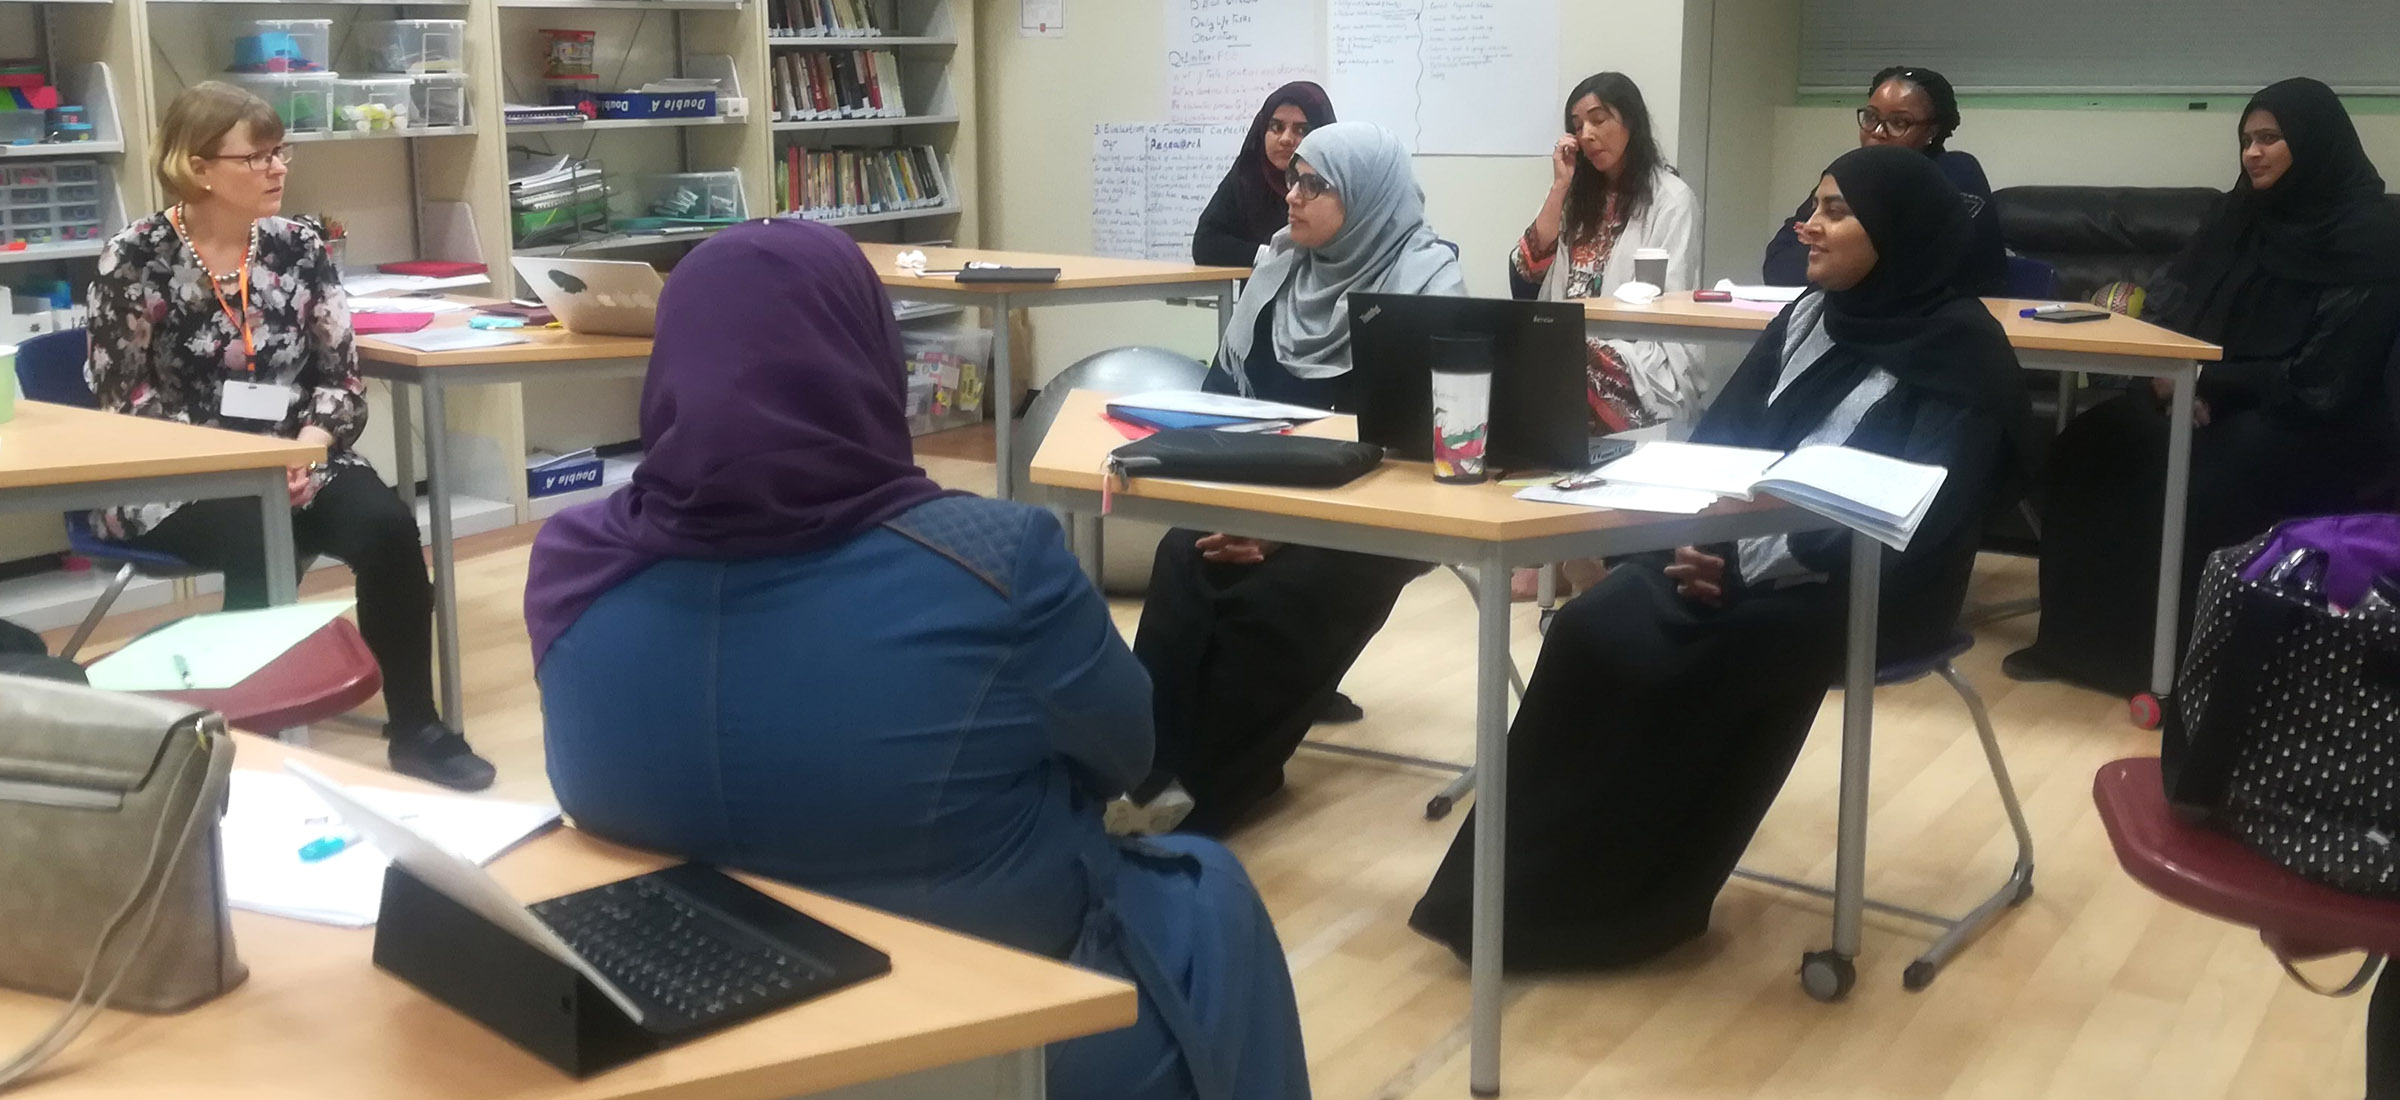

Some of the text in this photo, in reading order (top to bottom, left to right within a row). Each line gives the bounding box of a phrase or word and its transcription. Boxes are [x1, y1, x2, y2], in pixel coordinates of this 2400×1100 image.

[601, 100, 628, 111] Doubl
[652, 98, 706, 112] Double A
[1104, 123, 1145, 134] Evaluation
[1149, 123, 1158, 134] of
[1162, 123, 1206, 135] Functional
[546, 469, 597, 489] Double A
